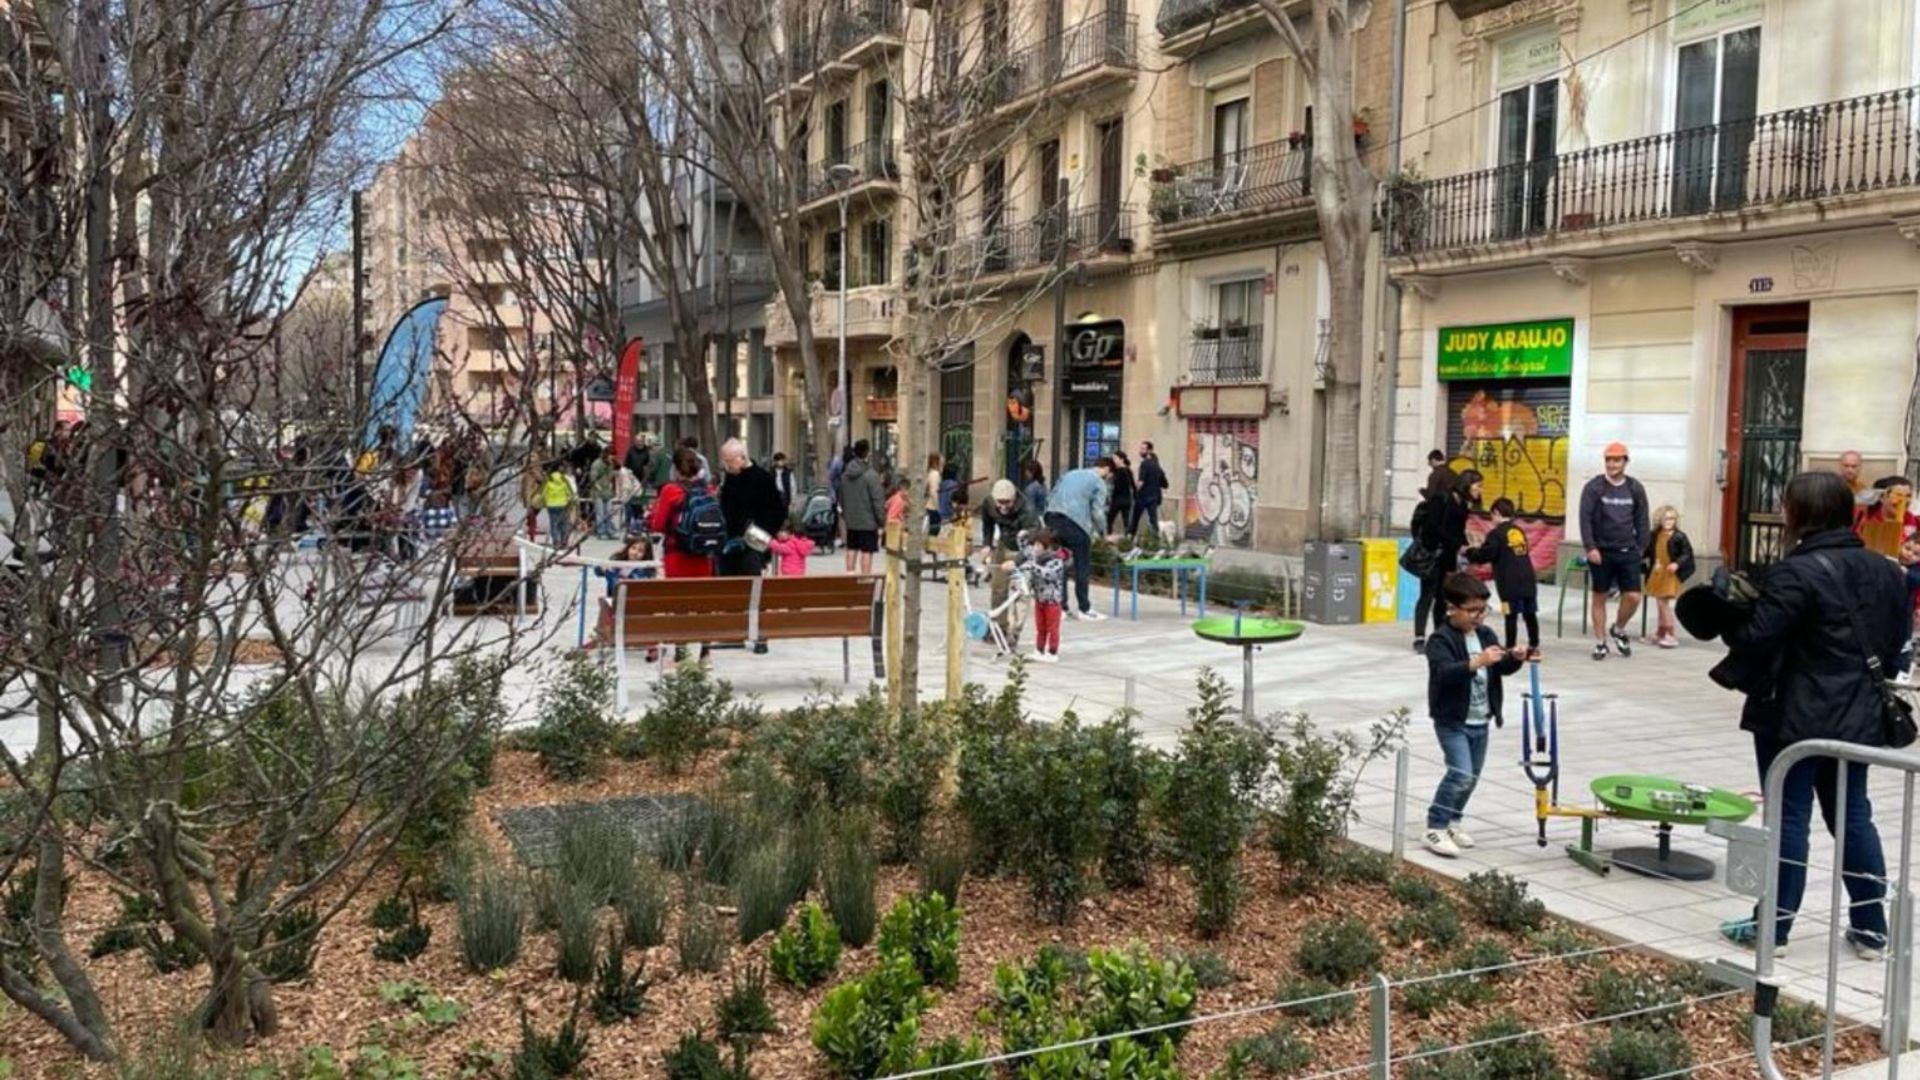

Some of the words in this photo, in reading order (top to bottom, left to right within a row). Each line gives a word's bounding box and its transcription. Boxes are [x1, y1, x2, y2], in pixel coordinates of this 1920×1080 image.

[1072, 330, 1115, 362] Gp
[1445, 332, 1489, 352] JUDY
[1492, 327, 1567, 350] ARAUJO
